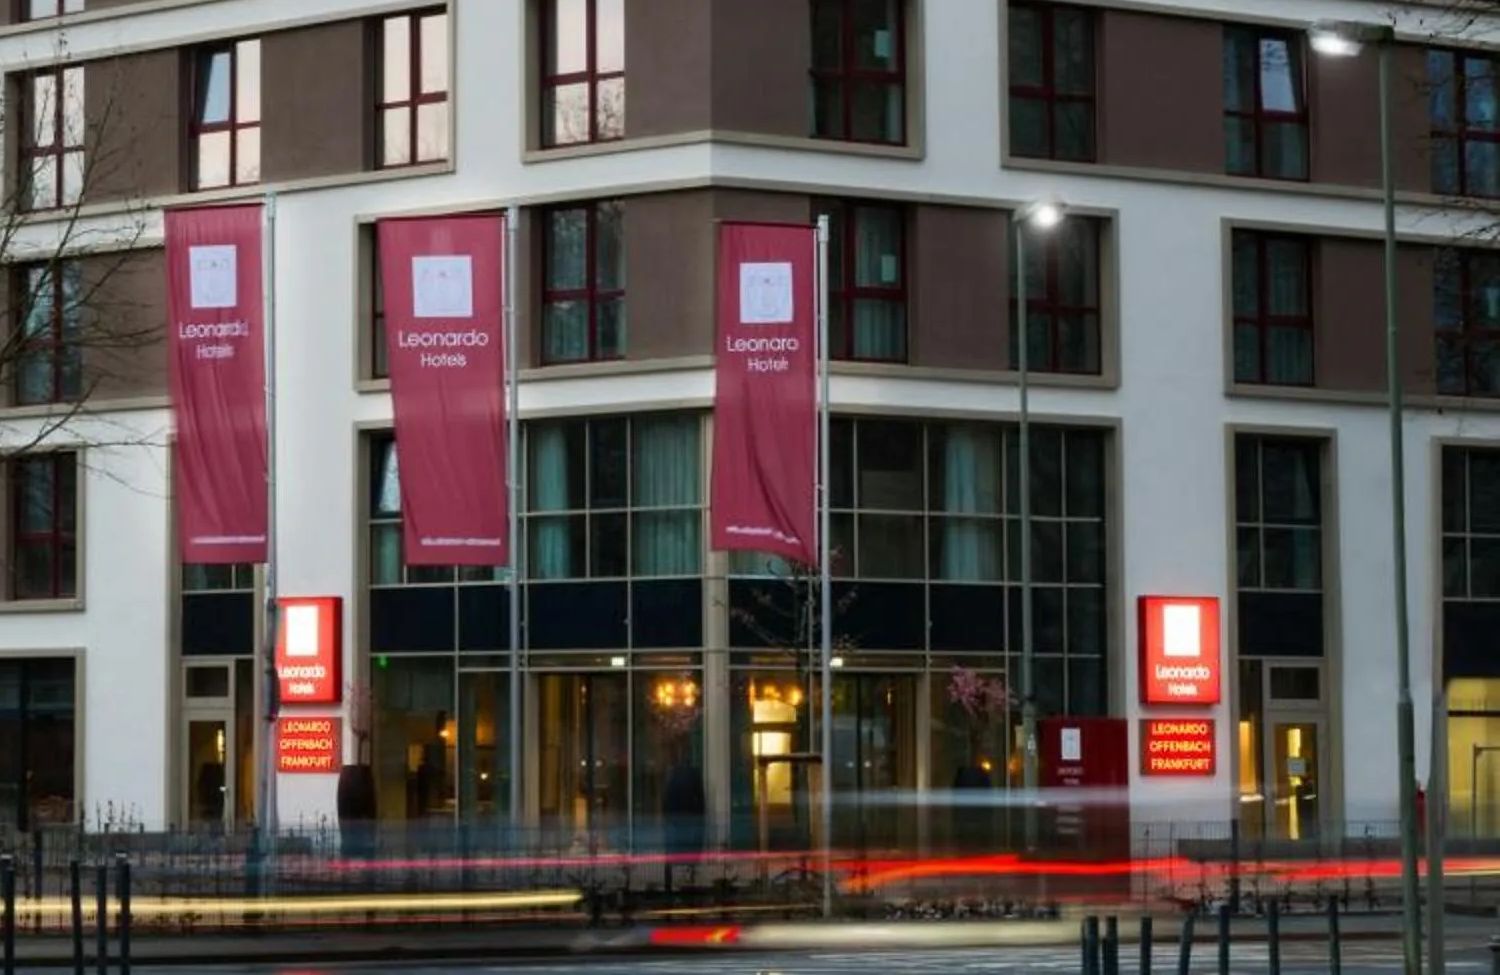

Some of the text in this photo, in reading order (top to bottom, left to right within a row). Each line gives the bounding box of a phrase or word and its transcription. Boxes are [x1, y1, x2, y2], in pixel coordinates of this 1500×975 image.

[398, 329, 489, 348] Leonardo
[420, 352, 467, 368] Hotels
[1155, 663, 1211, 681] Leonardo
[283, 720, 331, 733] LEONARDO
[1151, 722, 1208, 736] LEONARDO
[280, 738, 333, 750] OFFENBACH
[1149, 740, 1211, 753] OFFENBACH
[281, 756, 332, 769] FRANKFURT
[1151, 758, 1211, 770] FRANKFURT
